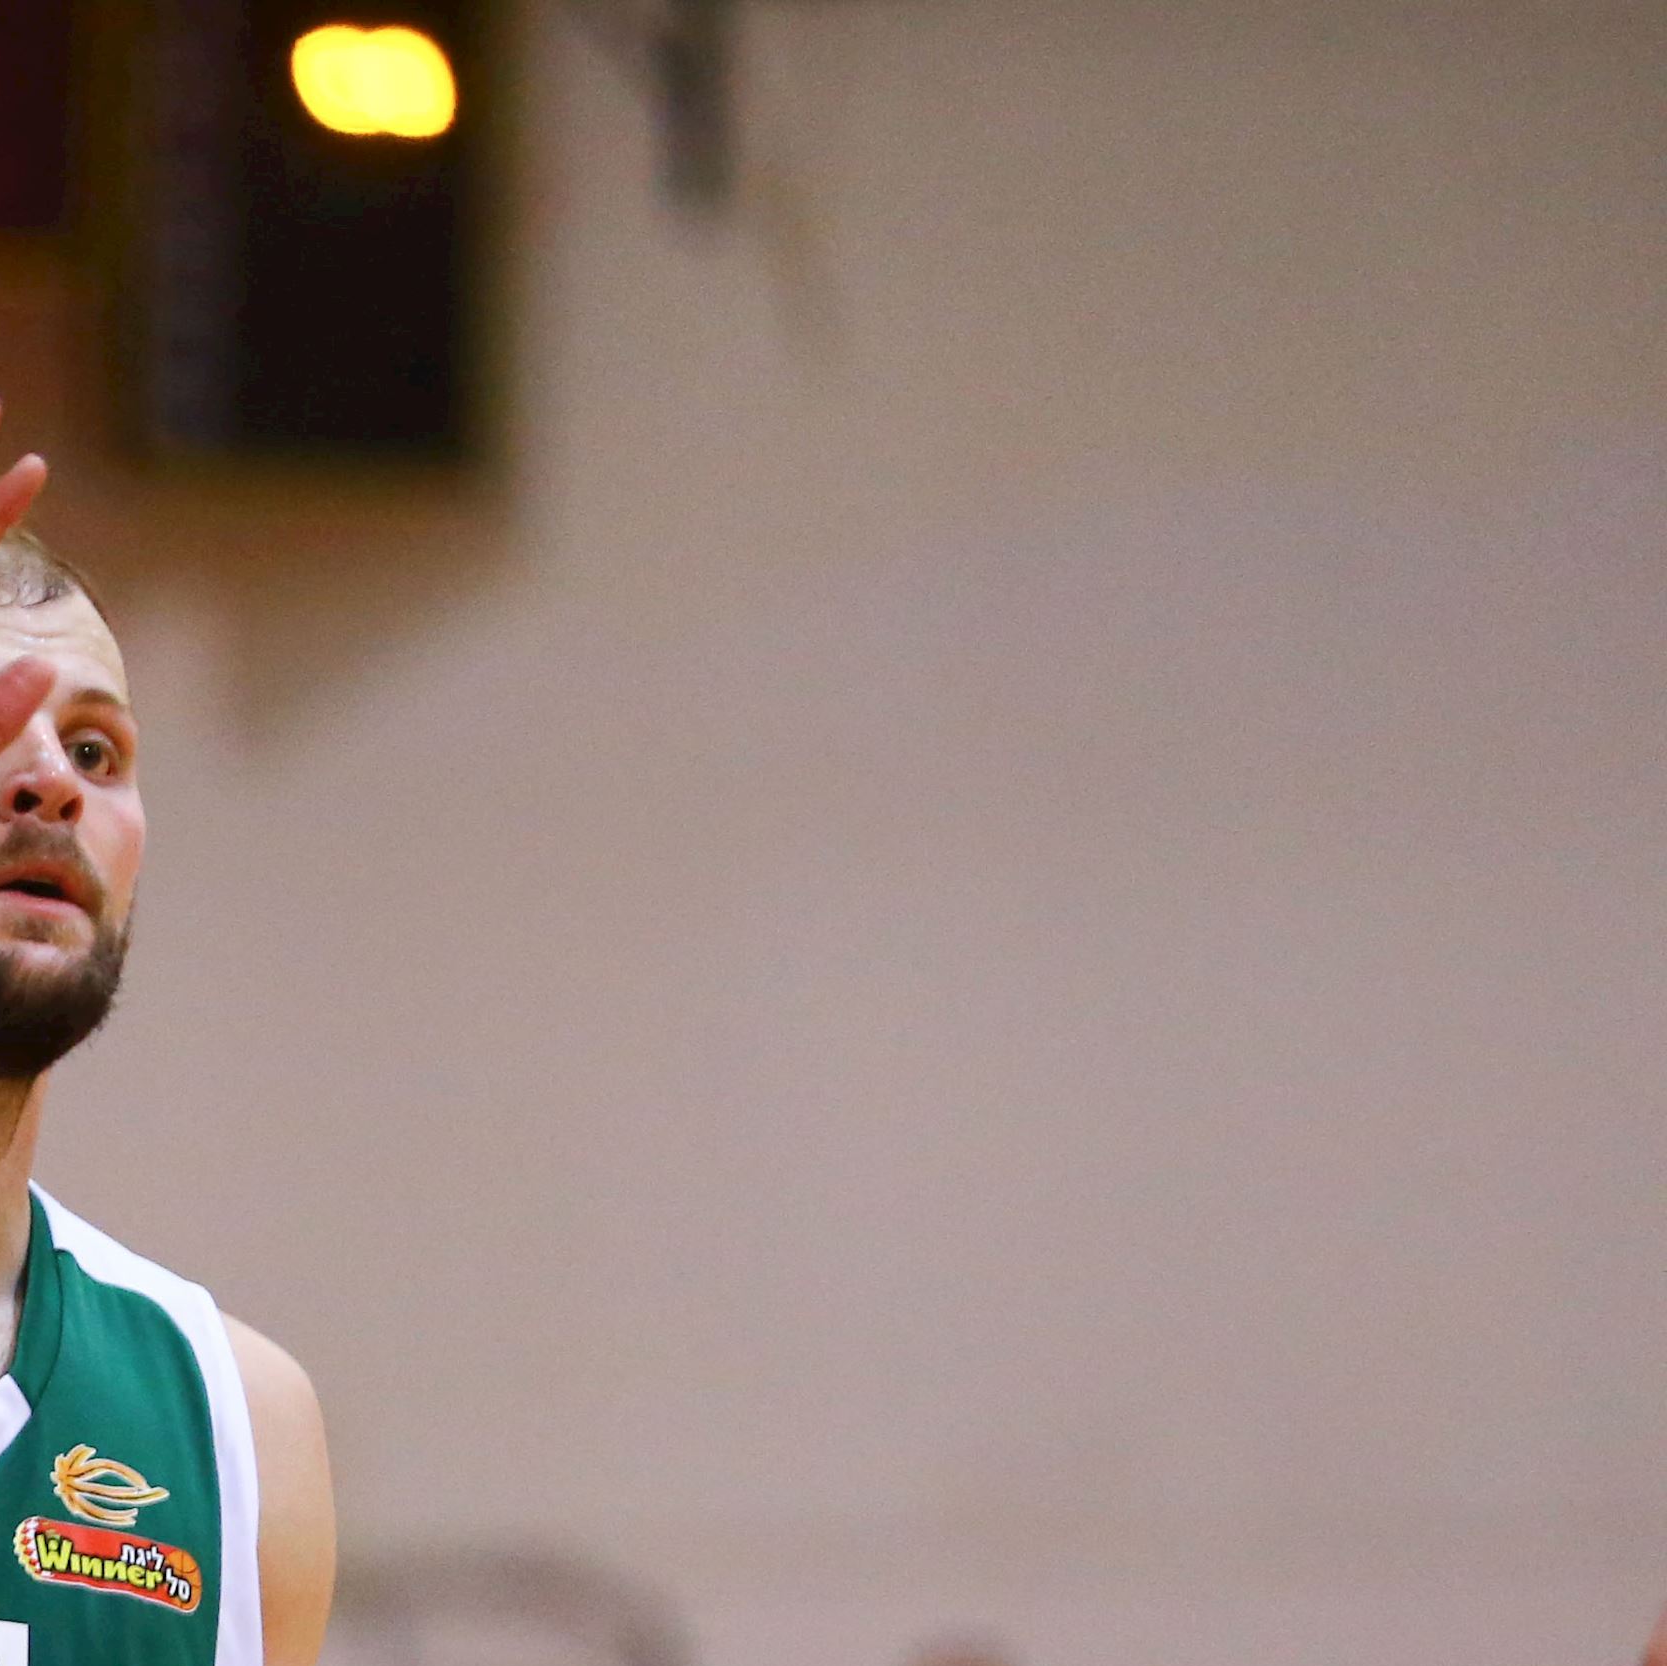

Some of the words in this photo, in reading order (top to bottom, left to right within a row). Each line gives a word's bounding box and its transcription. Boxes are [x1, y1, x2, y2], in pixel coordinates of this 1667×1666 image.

[36, 1533, 164, 1591] Winner
[166, 1567, 192, 1601] סל
[120, 1542, 165, 1571] ליגת
